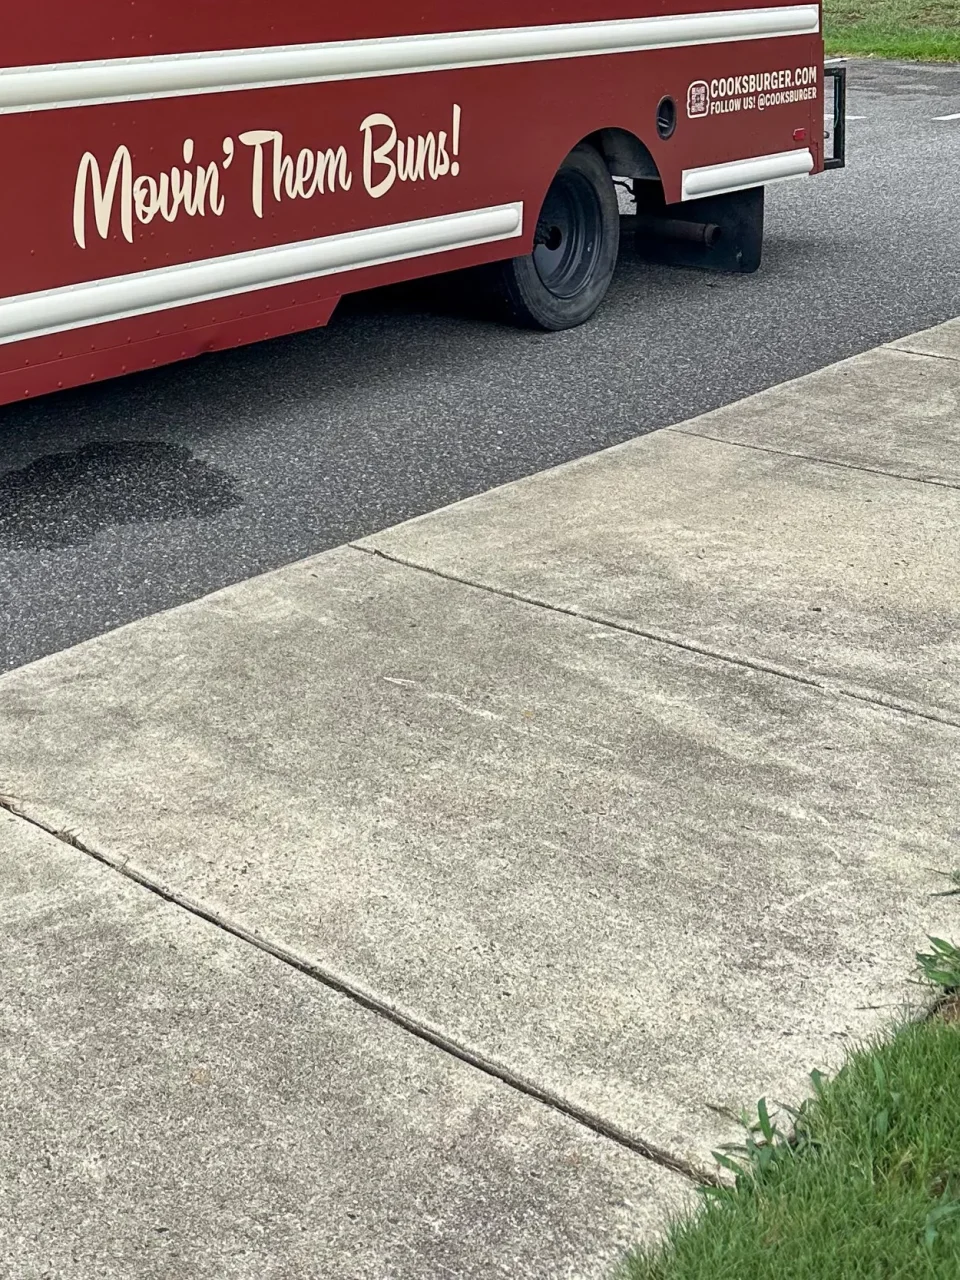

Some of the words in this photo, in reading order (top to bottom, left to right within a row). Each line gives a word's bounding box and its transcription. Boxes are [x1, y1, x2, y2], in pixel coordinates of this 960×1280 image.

[710, 65, 817, 99] COOKSBURGER.COM
[710, 98, 741, 115] FOLLOW
[742, 96, 756, 111] US!
[757, 86, 817, 111] @COOKSBURGER
[73, 136, 234, 250] Movin'
[238, 130, 352, 218] Them
[359, 103, 461, 199] Buns!
